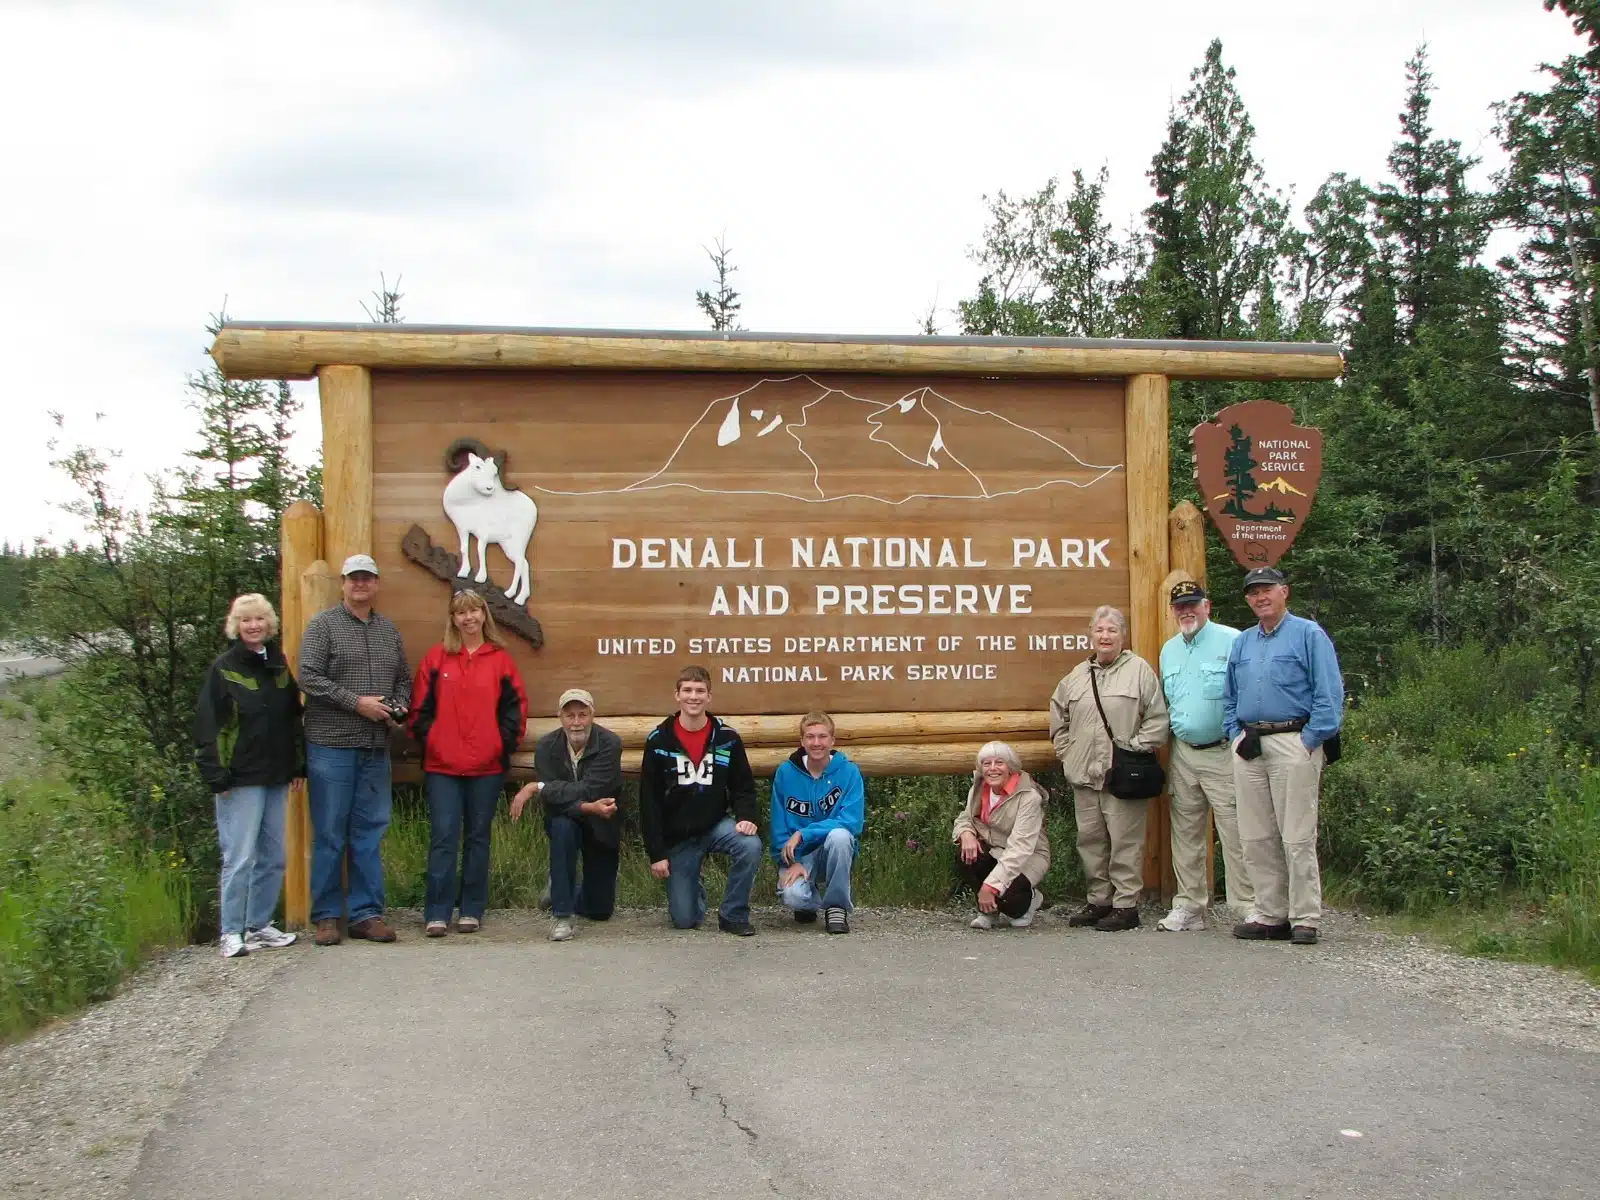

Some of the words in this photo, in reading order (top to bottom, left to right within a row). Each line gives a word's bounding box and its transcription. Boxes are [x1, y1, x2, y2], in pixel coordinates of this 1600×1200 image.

[1258, 439, 1311, 449] NATIONAL
[1269, 451, 1298, 460] PARK
[1261, 461, 1306, 472] SERVICE
[1235, 524, 1283, 533] Department
[1231, 531, 1240, 539] of
[1241, 532, 1255, 540] the
[611, 537, 764, 569] DENALI
[790, 536, 987, 568] NATIONAL
[1012, 538, 1111, 568] PARK
[708, 585, 789, 616] AND
[815, 584, 1032, 615] PRESERVE
[597, 638, 676, 655] UNITED
[688, 637, 772, 654] STATES
[784, 635, 926, 653] DEPARTMENT
[938, 635, 964, 652] OF
[975, 635, 1017, 651] THE
[722, 665, 828, 684] NATIONAL
[841, 665, 895, 682] PARK
[907, 664, 997, 681] SERVICE
